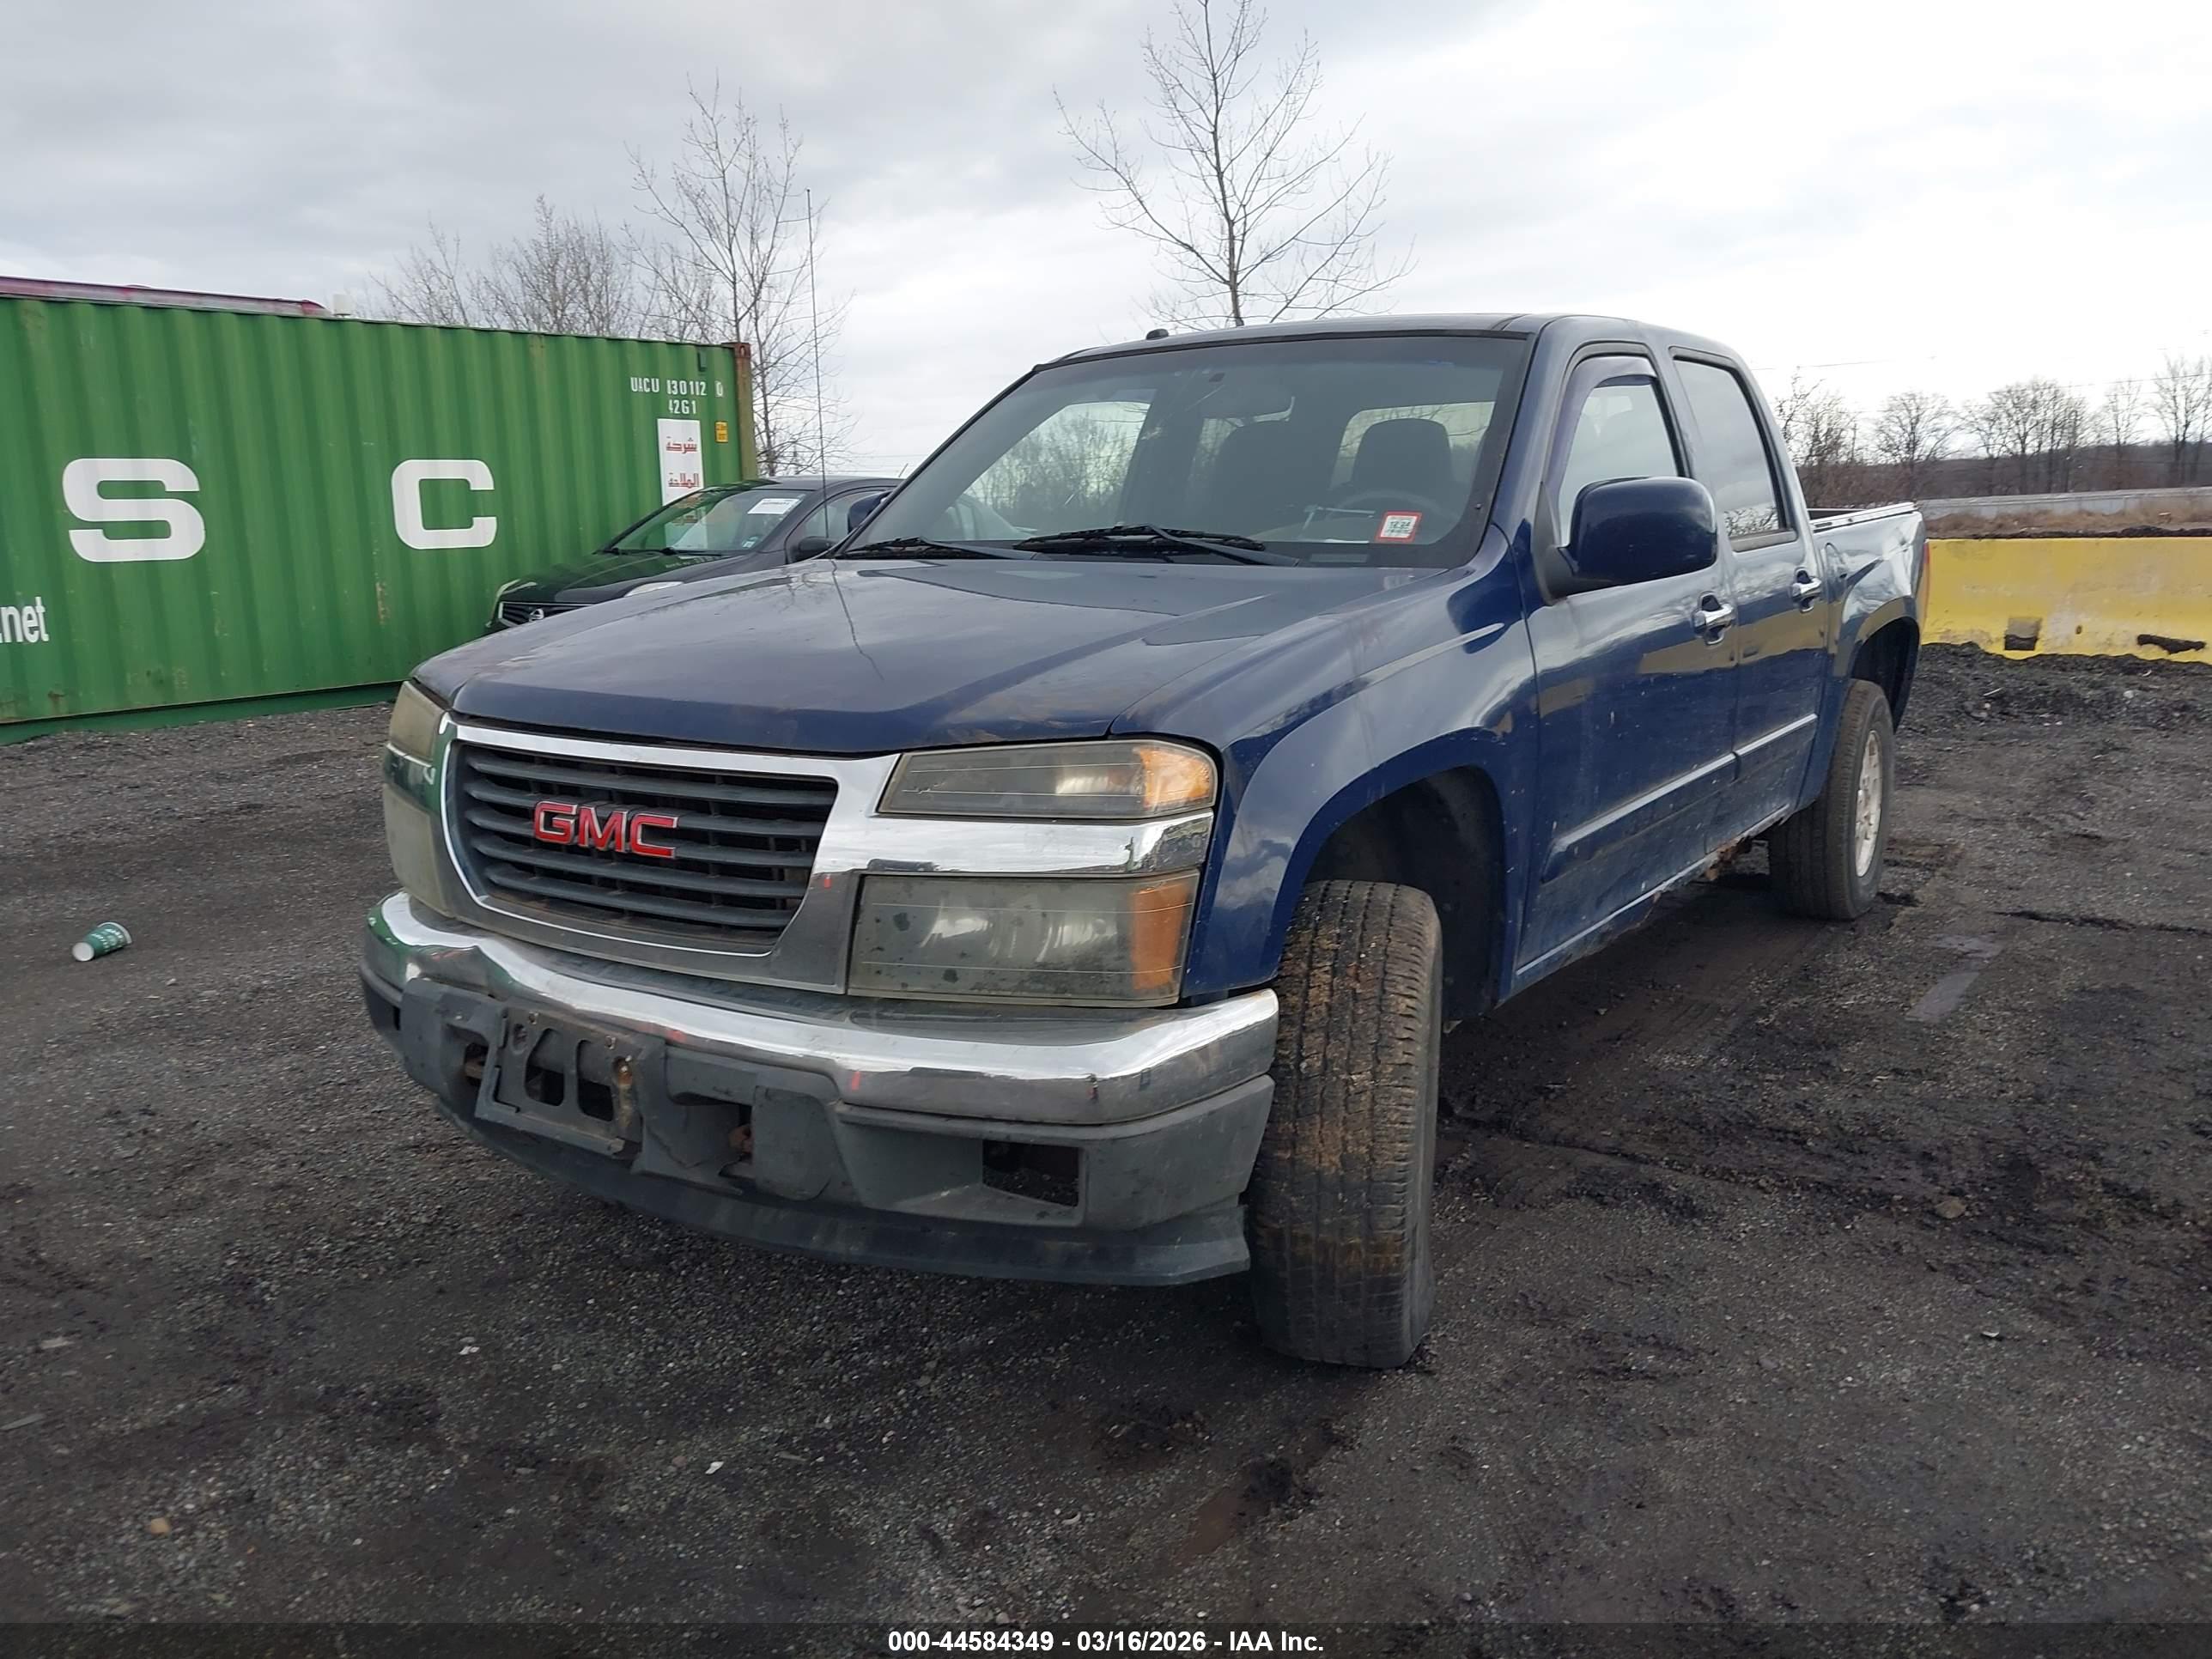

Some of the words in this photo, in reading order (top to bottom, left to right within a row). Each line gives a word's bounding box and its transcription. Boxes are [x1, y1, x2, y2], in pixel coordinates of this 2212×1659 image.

[666, 380, 708, 396] 130112
[63, 458, 206, 562] S
[392, 459, 498, 550] C
[534, 800, 678, 859] GMC
